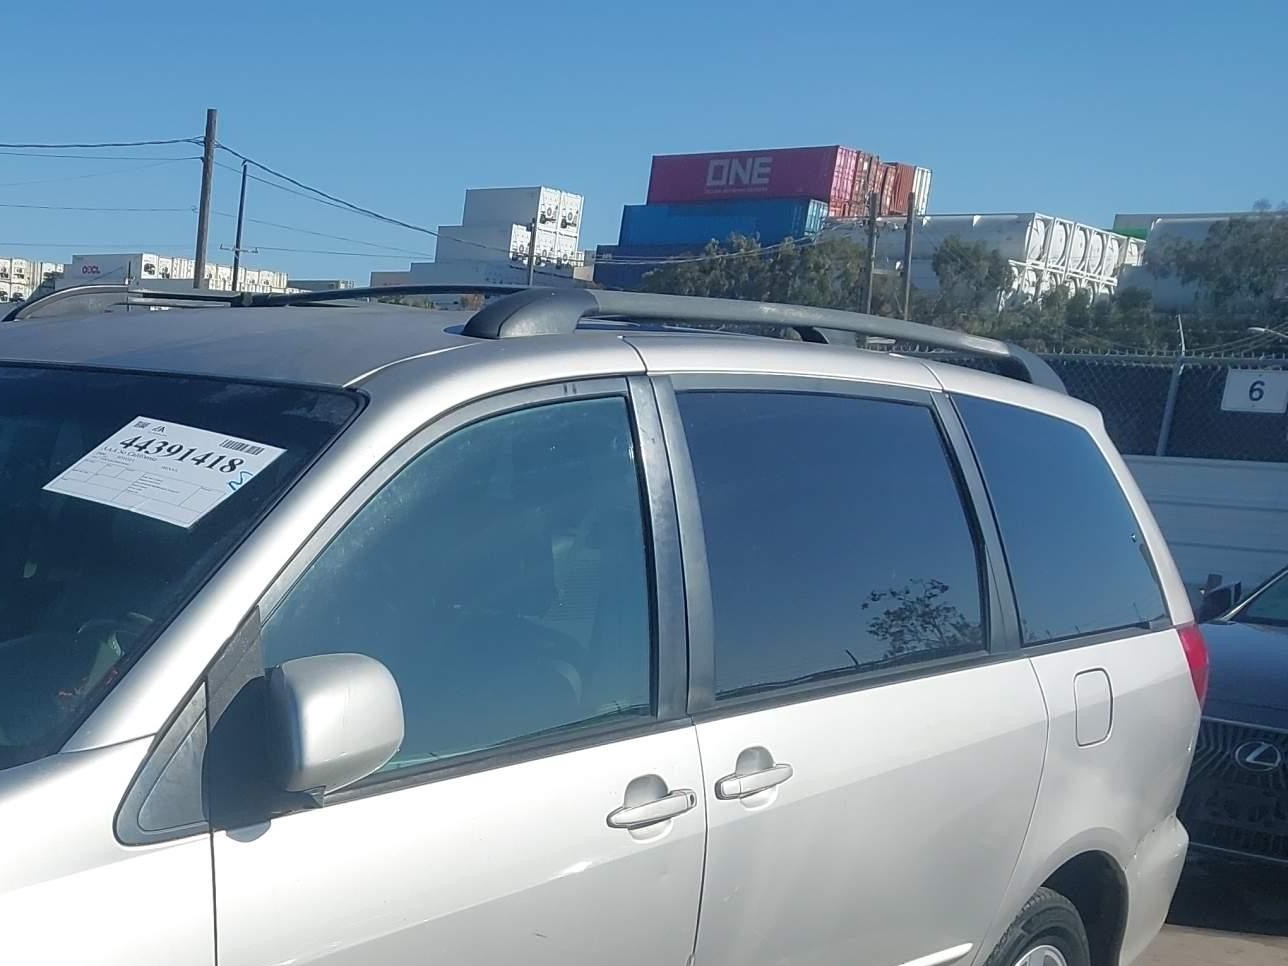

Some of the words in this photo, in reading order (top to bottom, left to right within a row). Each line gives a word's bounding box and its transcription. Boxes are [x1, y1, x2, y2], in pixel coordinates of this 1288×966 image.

[705, 157, 773, 186] ONE
[1249, 380, 1265, 402] 6
[120, 435, 245, 473] 44391418
